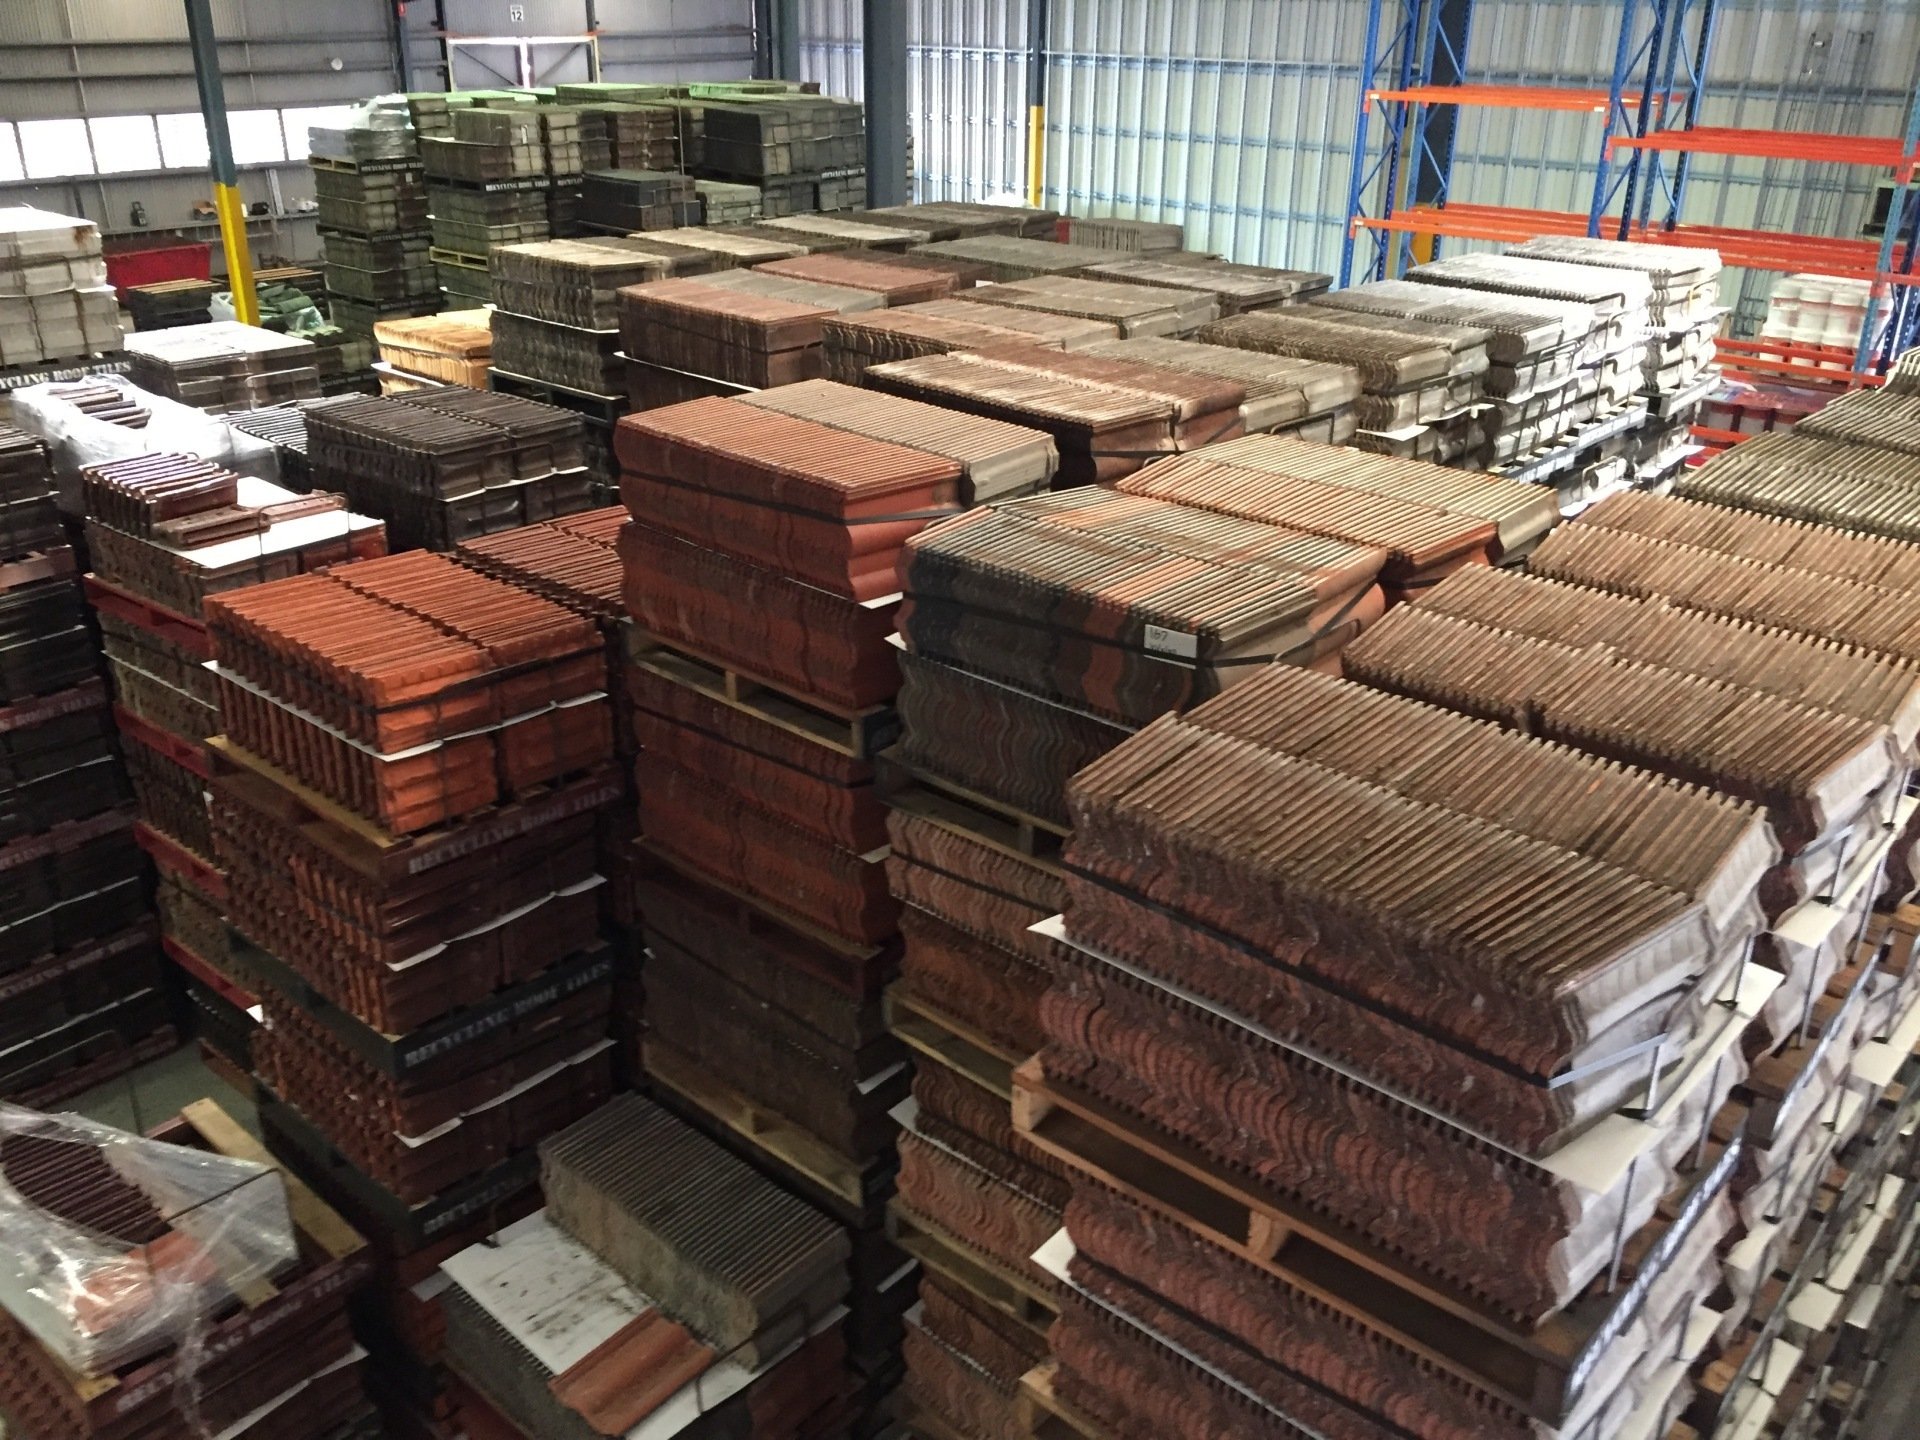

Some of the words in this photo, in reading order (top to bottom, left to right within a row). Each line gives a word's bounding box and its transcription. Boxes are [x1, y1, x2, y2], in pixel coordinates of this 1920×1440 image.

[512, 11, 522, 20] 12
[53, 367, 90, 381] ROOF
[92, 361, 132, 374] TILES
[408, 824, 515, 875] RECYCLING
[573, 786, 620, 811] TILES
